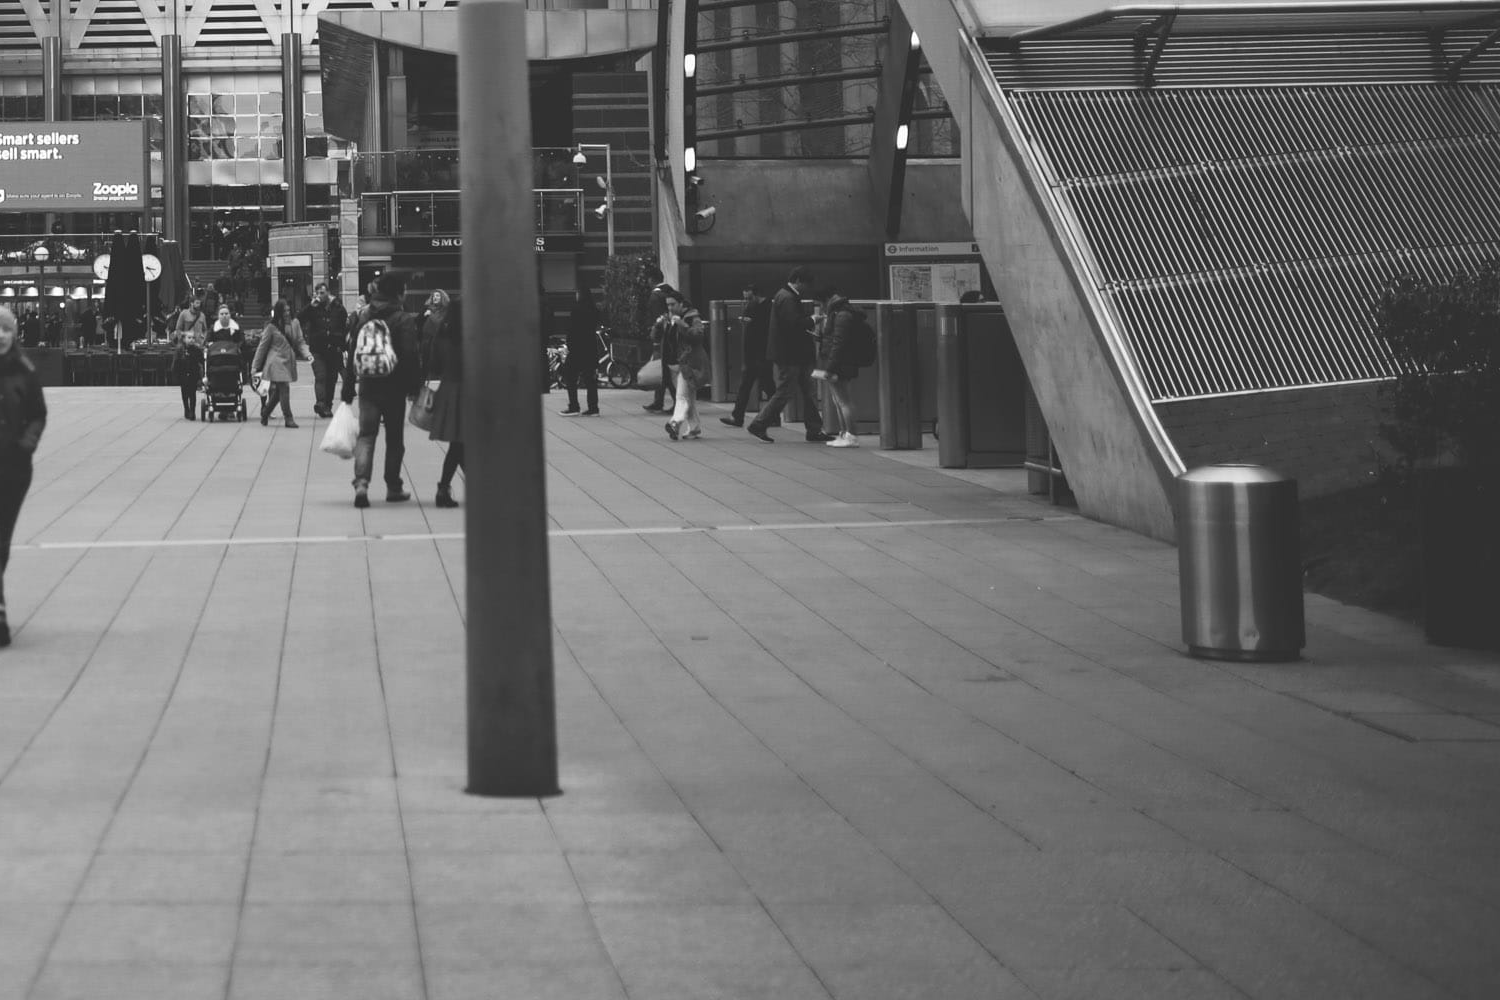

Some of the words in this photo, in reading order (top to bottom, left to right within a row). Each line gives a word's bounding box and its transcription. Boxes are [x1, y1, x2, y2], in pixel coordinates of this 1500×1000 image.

[37, 132, 80, 145] sellers
[20, 147, 63, 160] smart.
[93, 182, 138, 196] Zoopla
[900, 245, 940, 254] Information
